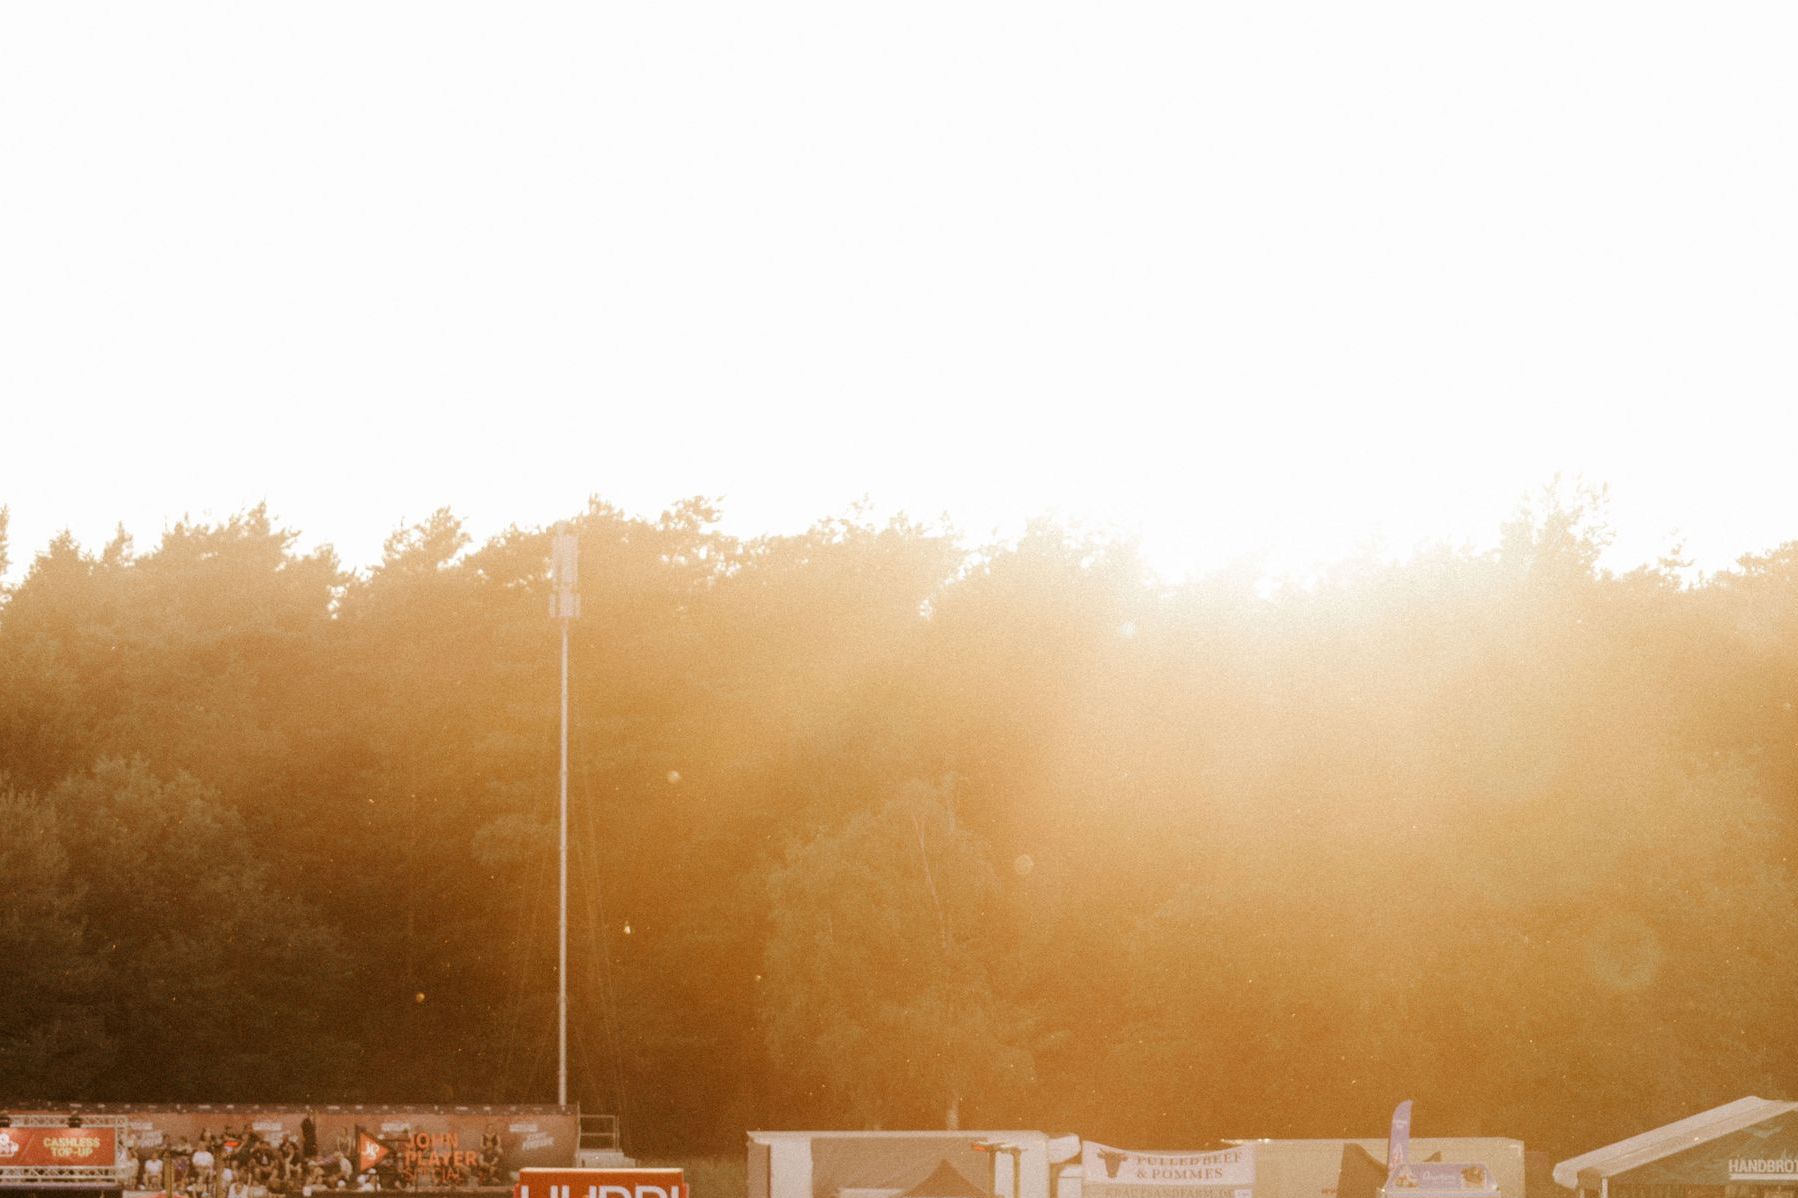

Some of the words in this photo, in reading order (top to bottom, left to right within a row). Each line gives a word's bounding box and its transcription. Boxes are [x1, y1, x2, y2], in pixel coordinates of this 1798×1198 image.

[43, 1137, 101, 1148] CASHLESS
[52, 1147, 94, 1158] TOP-UP
[404, 1151, 478, 1166] PLAYER
[1152, 1167, 1223, 1180] POMMES
